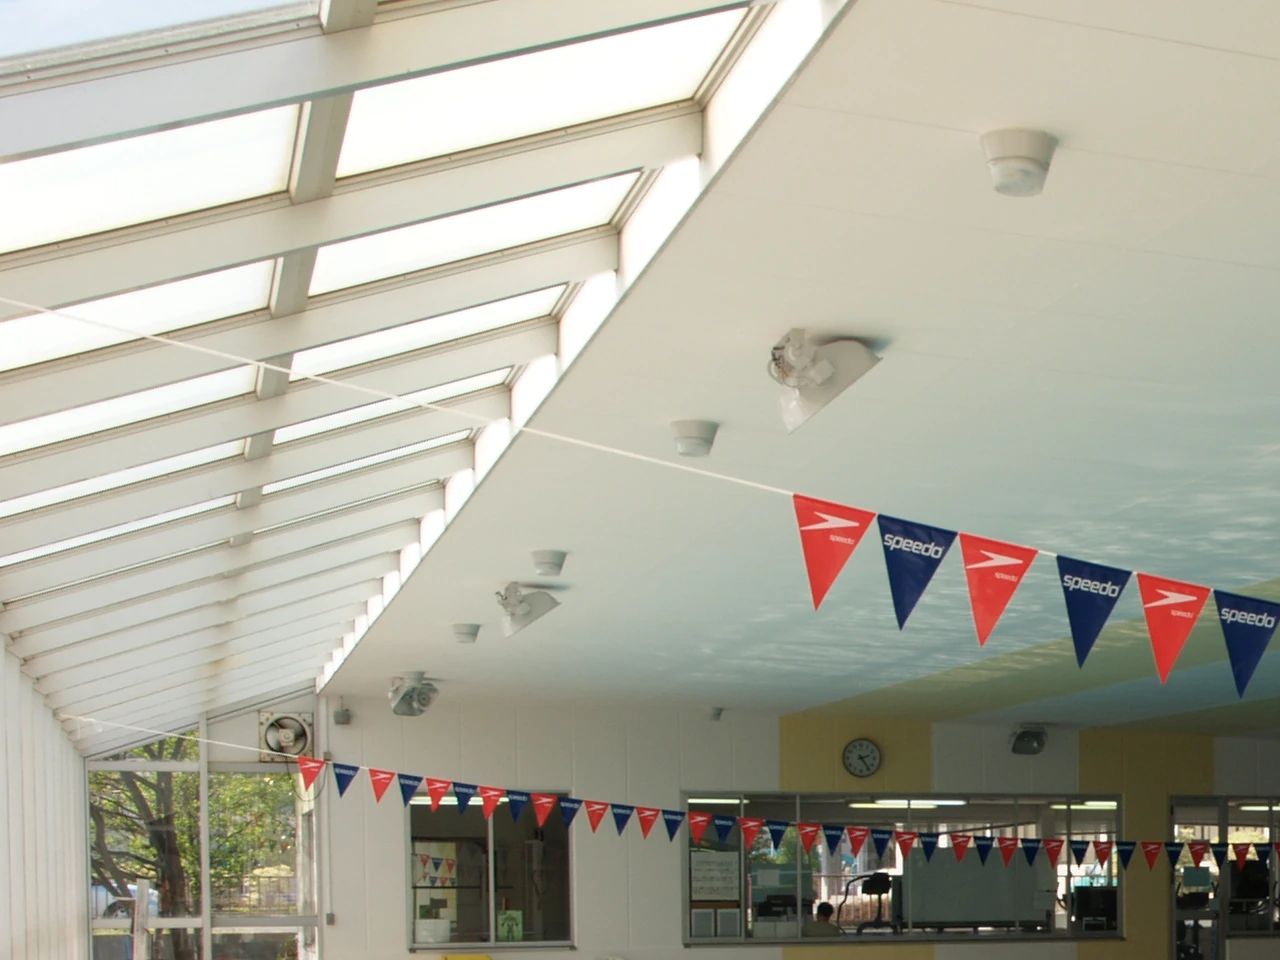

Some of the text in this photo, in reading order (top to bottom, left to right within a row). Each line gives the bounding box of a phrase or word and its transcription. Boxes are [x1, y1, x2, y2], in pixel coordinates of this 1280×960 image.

[884, 533, 943, 559] speedo
[1063, 574, 1120, 597] speedo
[1220, 607, 1275, 628] speedo
